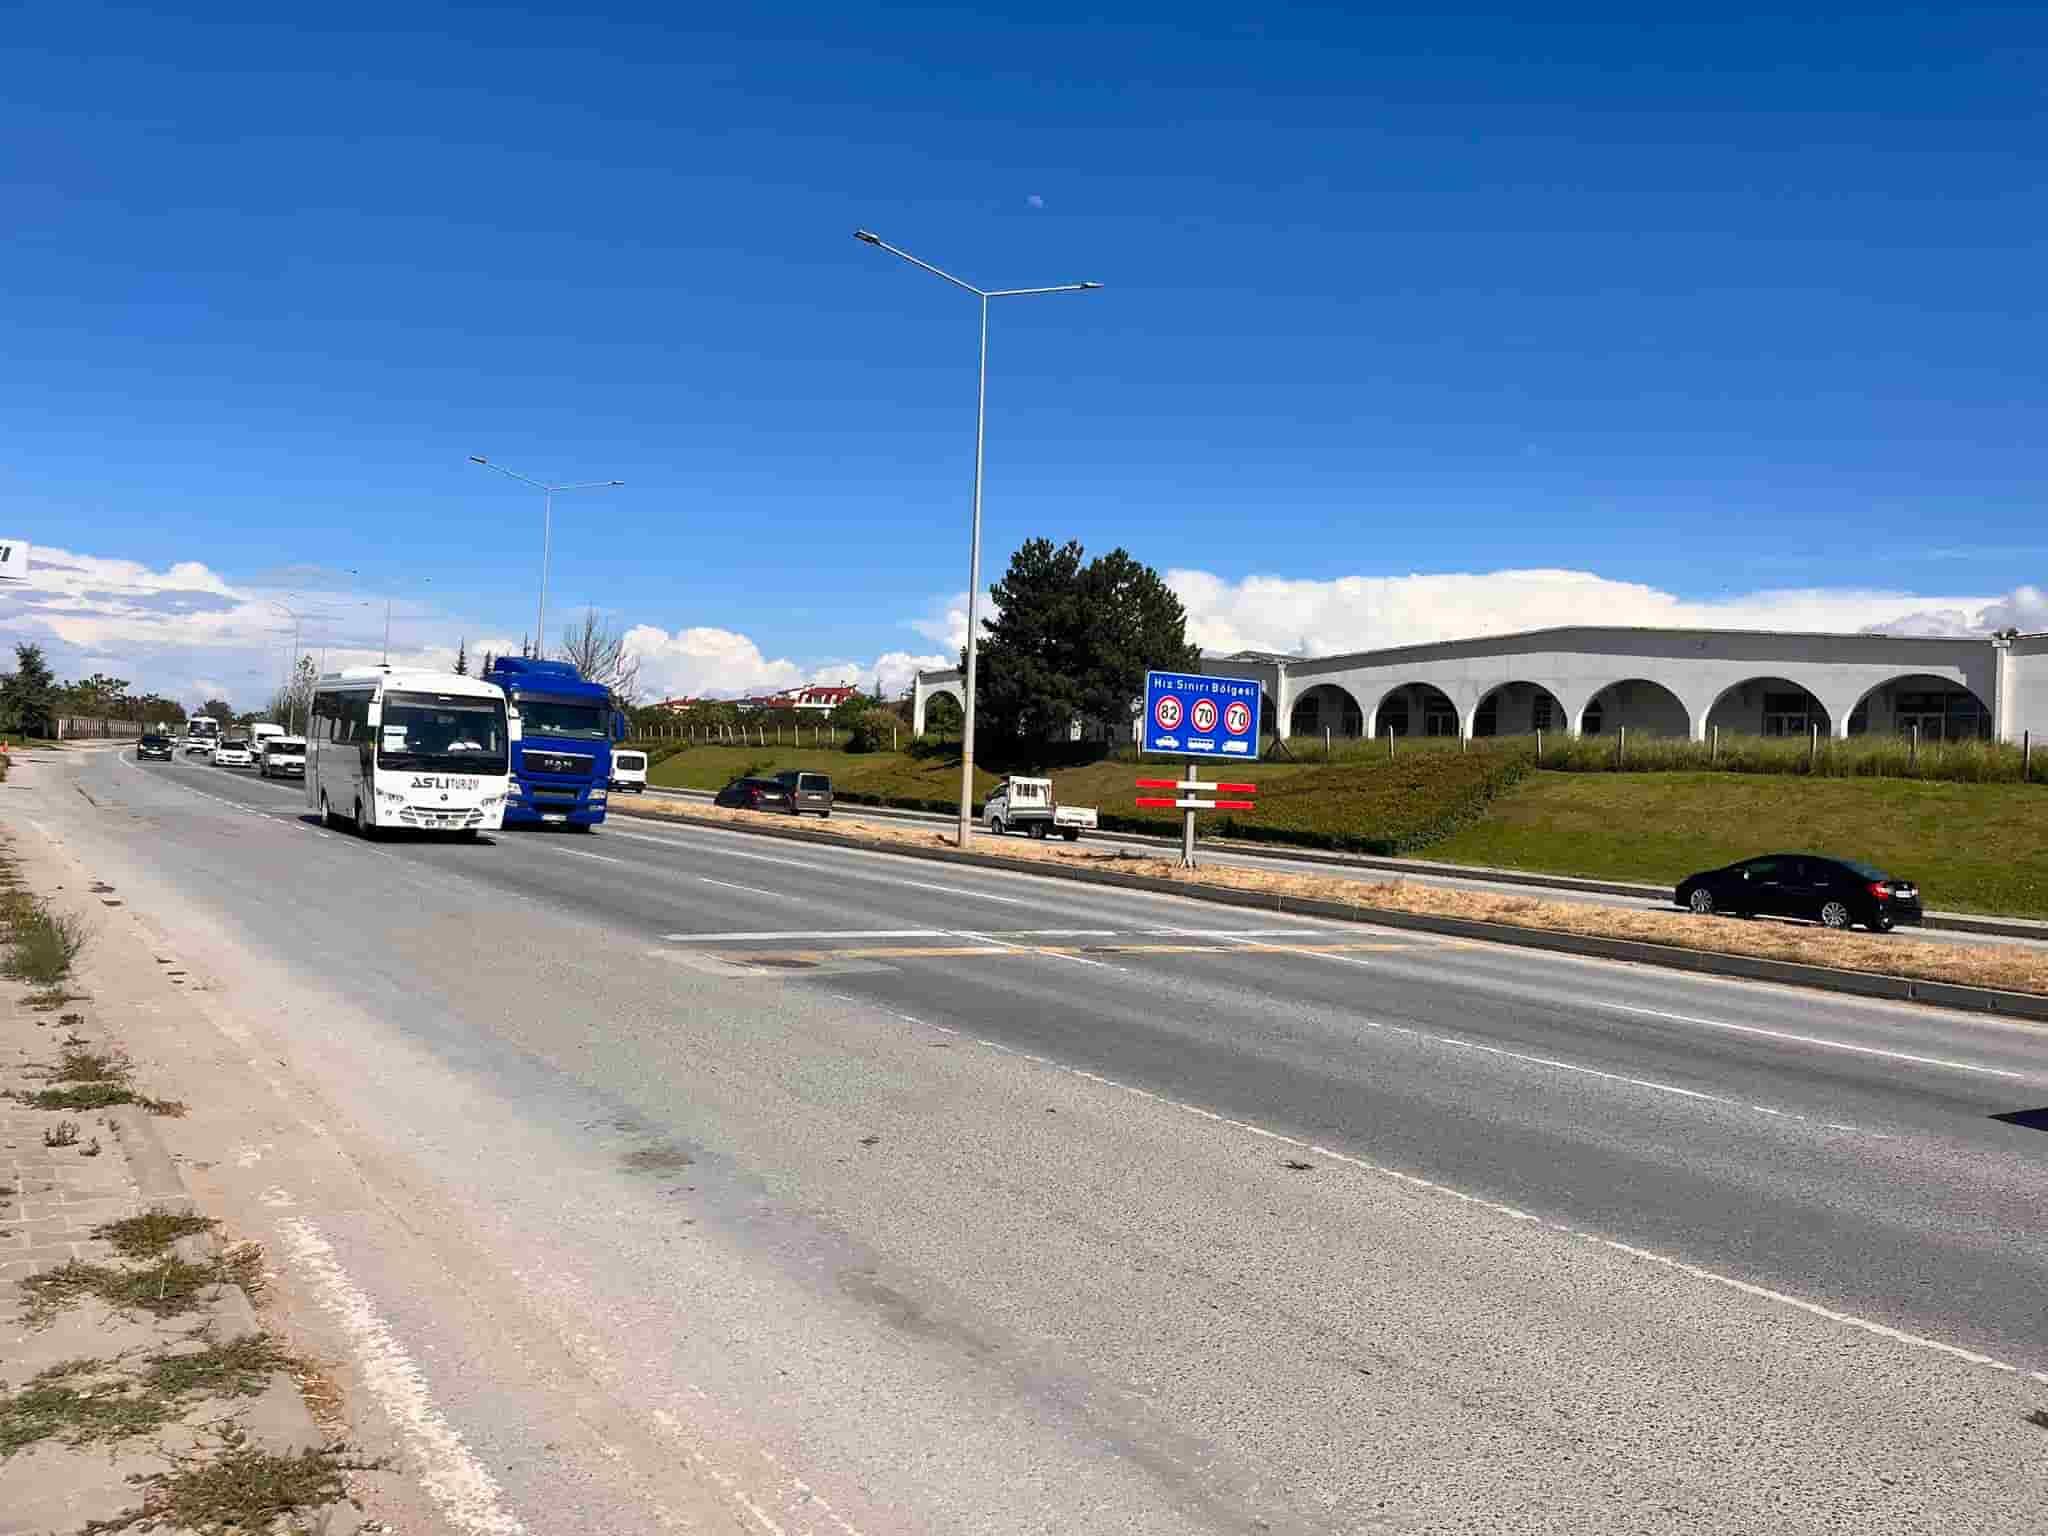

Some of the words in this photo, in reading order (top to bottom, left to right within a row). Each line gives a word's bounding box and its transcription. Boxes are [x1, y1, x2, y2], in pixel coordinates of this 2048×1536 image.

[1161, 704, 1177, 720] 82
[1199, 708, 1212, 724] 70
[1231, 710, 1245, 726] 70
